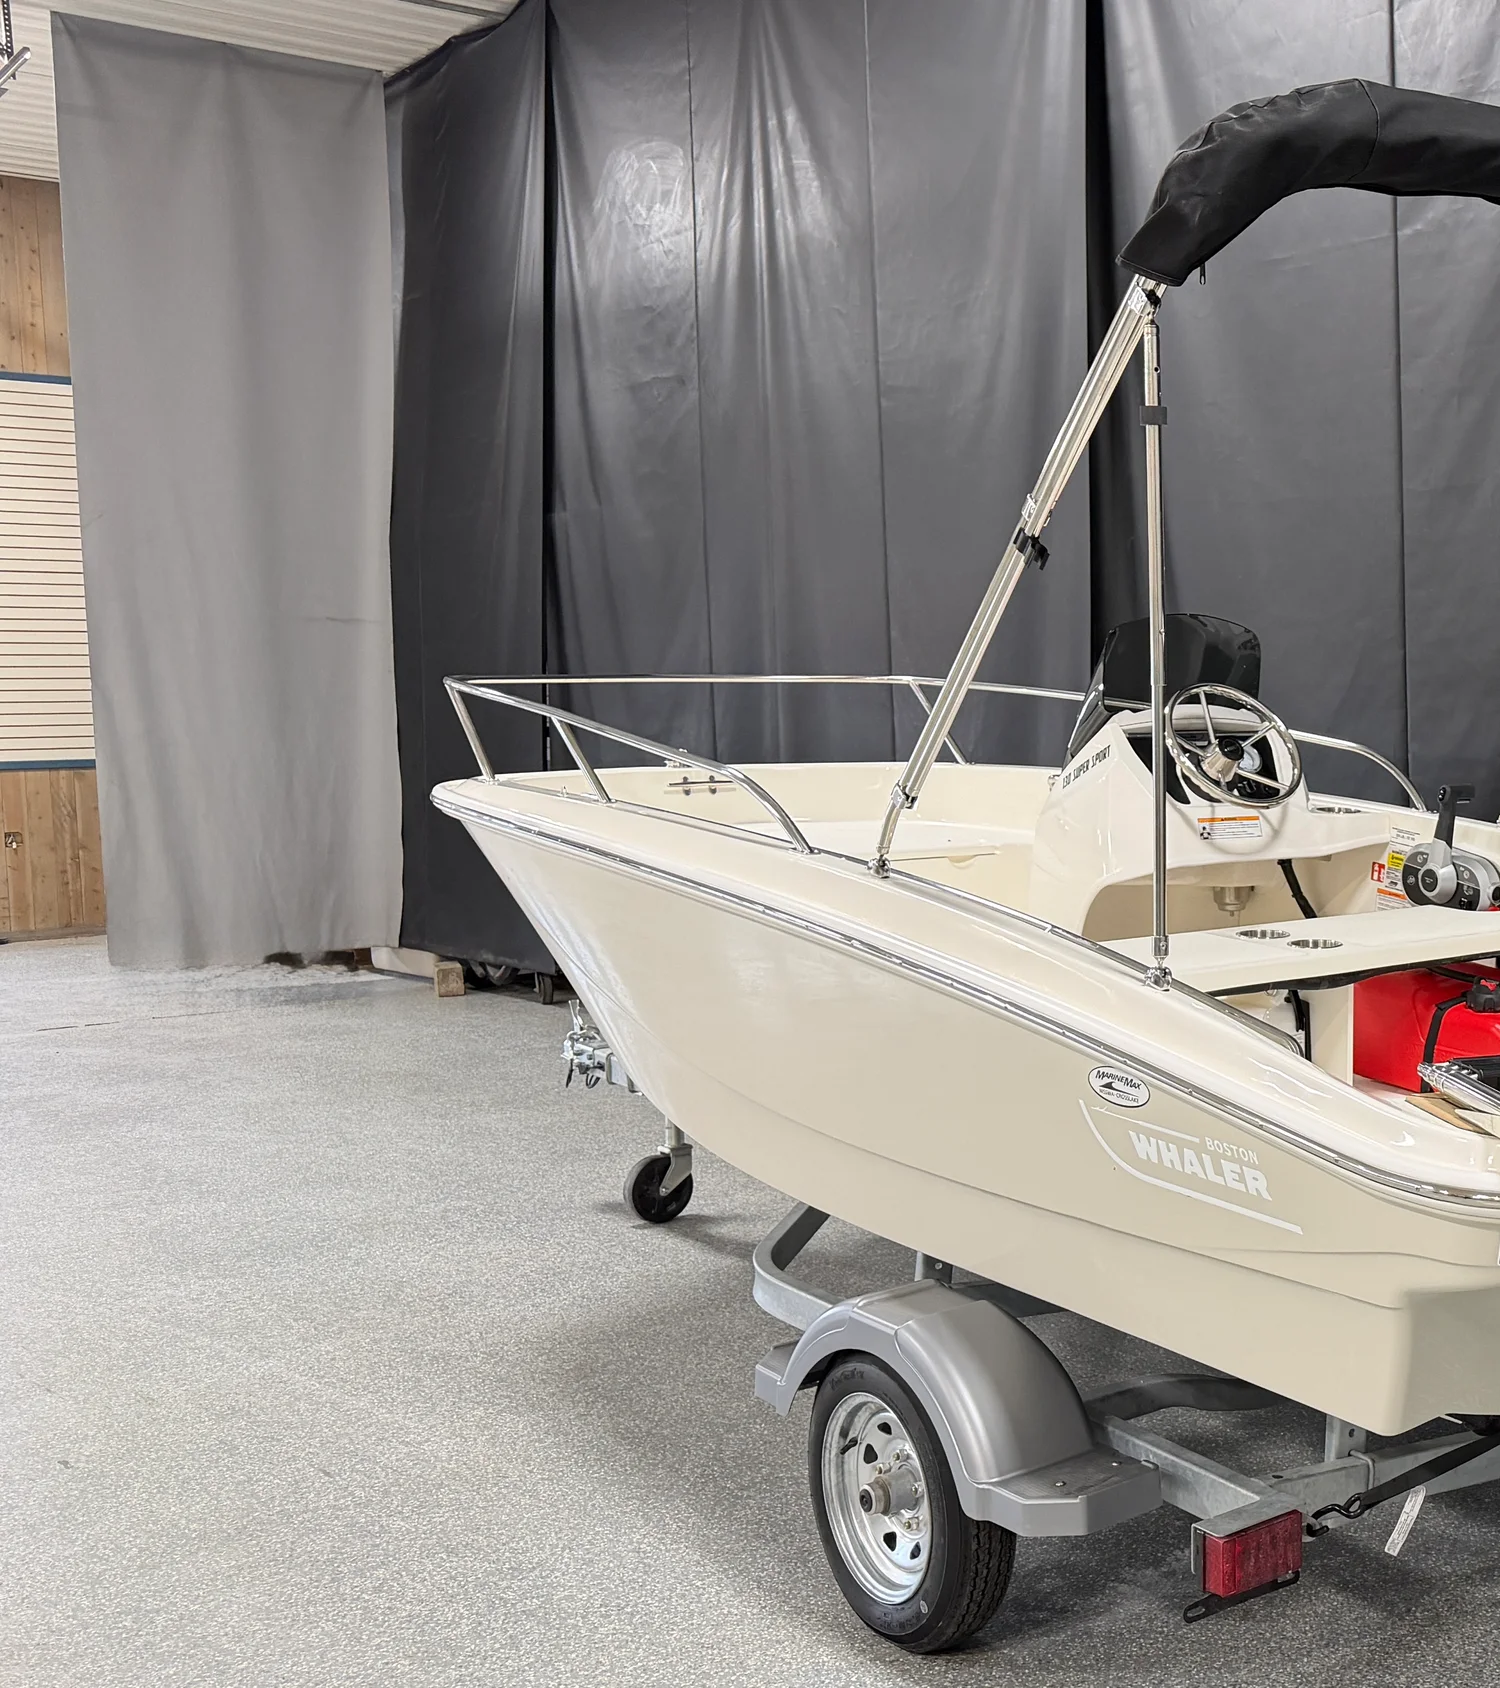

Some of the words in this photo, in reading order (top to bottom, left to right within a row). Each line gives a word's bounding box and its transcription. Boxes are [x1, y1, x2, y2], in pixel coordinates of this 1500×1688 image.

[1072, 759, 1090, 782] SUPER
[1091, 744, 1111, 769] SPORT
[1128, 1129, 1273, 1201] WHALER
[1204, 1136, 1259, 1165] BOSTON
